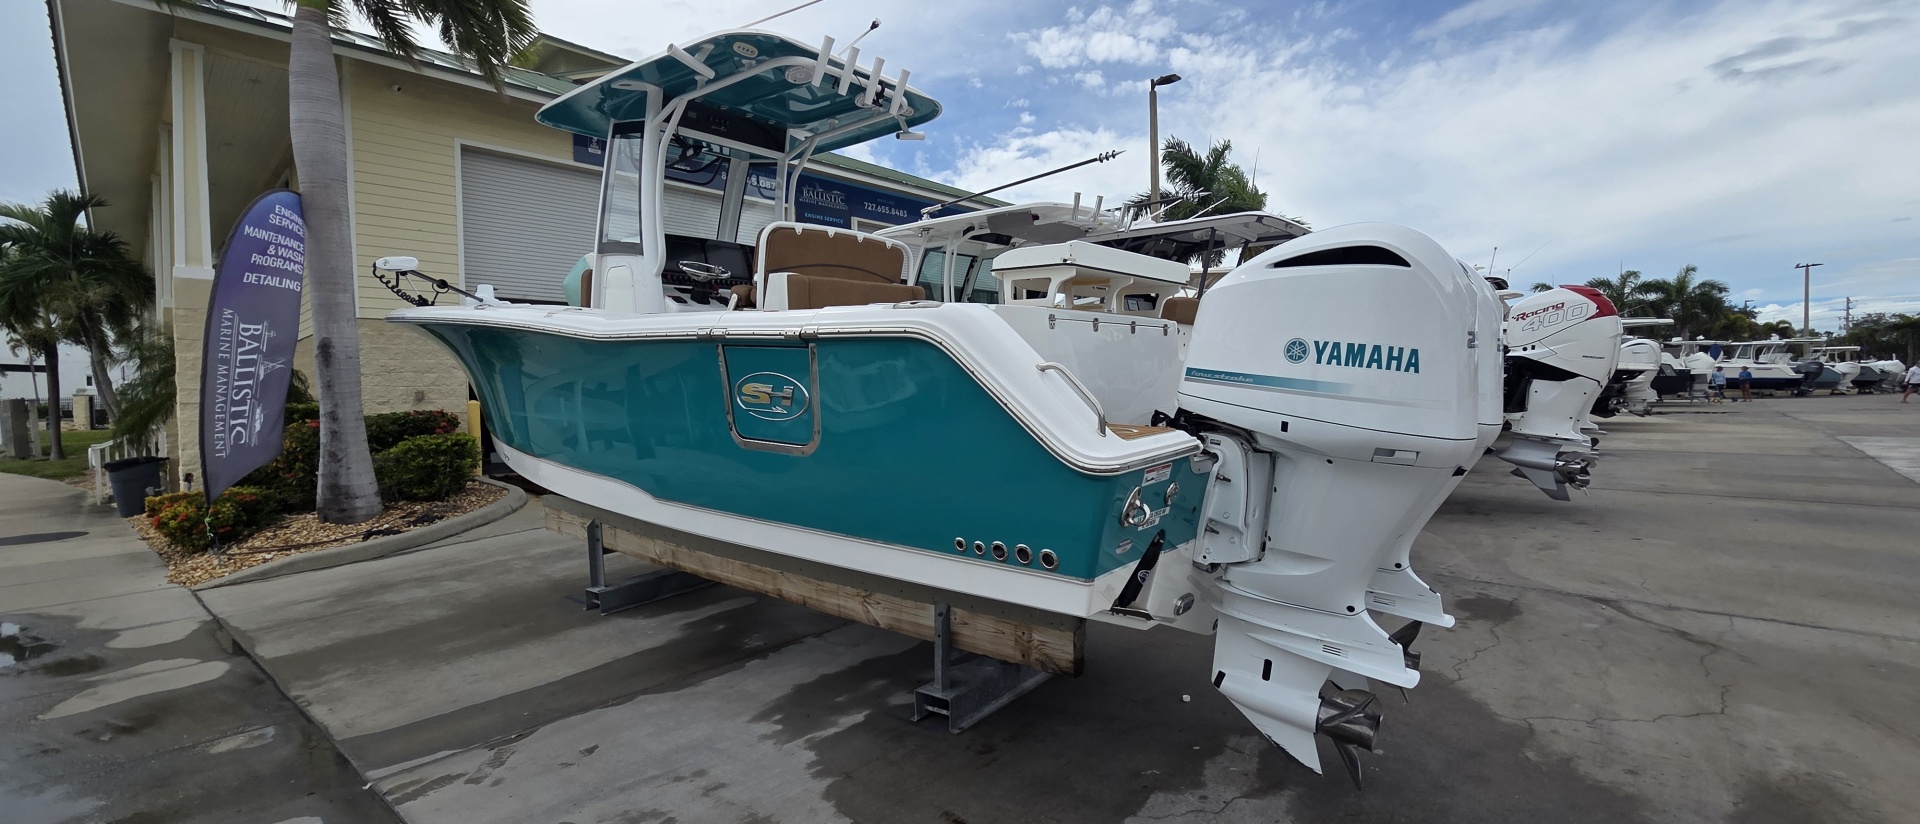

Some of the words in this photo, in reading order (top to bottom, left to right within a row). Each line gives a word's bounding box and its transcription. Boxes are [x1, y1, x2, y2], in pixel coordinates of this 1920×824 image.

[799, 197, 817, 205] MARINE
[818, 202, 848, 211] MANAGEMENT
[803, 188, 846, 205] BALLISTIC
[275, 204, 305, 228] ENGINE
[804, 212, 823, 220] ENGINE
[824, 215, 844, 224] SERVICE
[863, 201, 908, 218] 727.655.8483
[268, 213, 305, 238] SERVICE
[244, 224, 305, 254] MAINTENANCE
[250, 253, 304, 275] PROGRAMS
[267, 244, 276, 255] &
[277, 246, 304, 264] WASH
[243, 272, 302, 292] DETAILING
[1516, 302, 1565, 322] Racing
[1522, 303, 1589, 332] 400
[218, 308, 234, 360] MARINE
[1313, 340, 1420, 374] YAMAHA
[230, 322, 263, 446] BALLISTIC
[214, 364, 230, 459] MANAGEMENT
